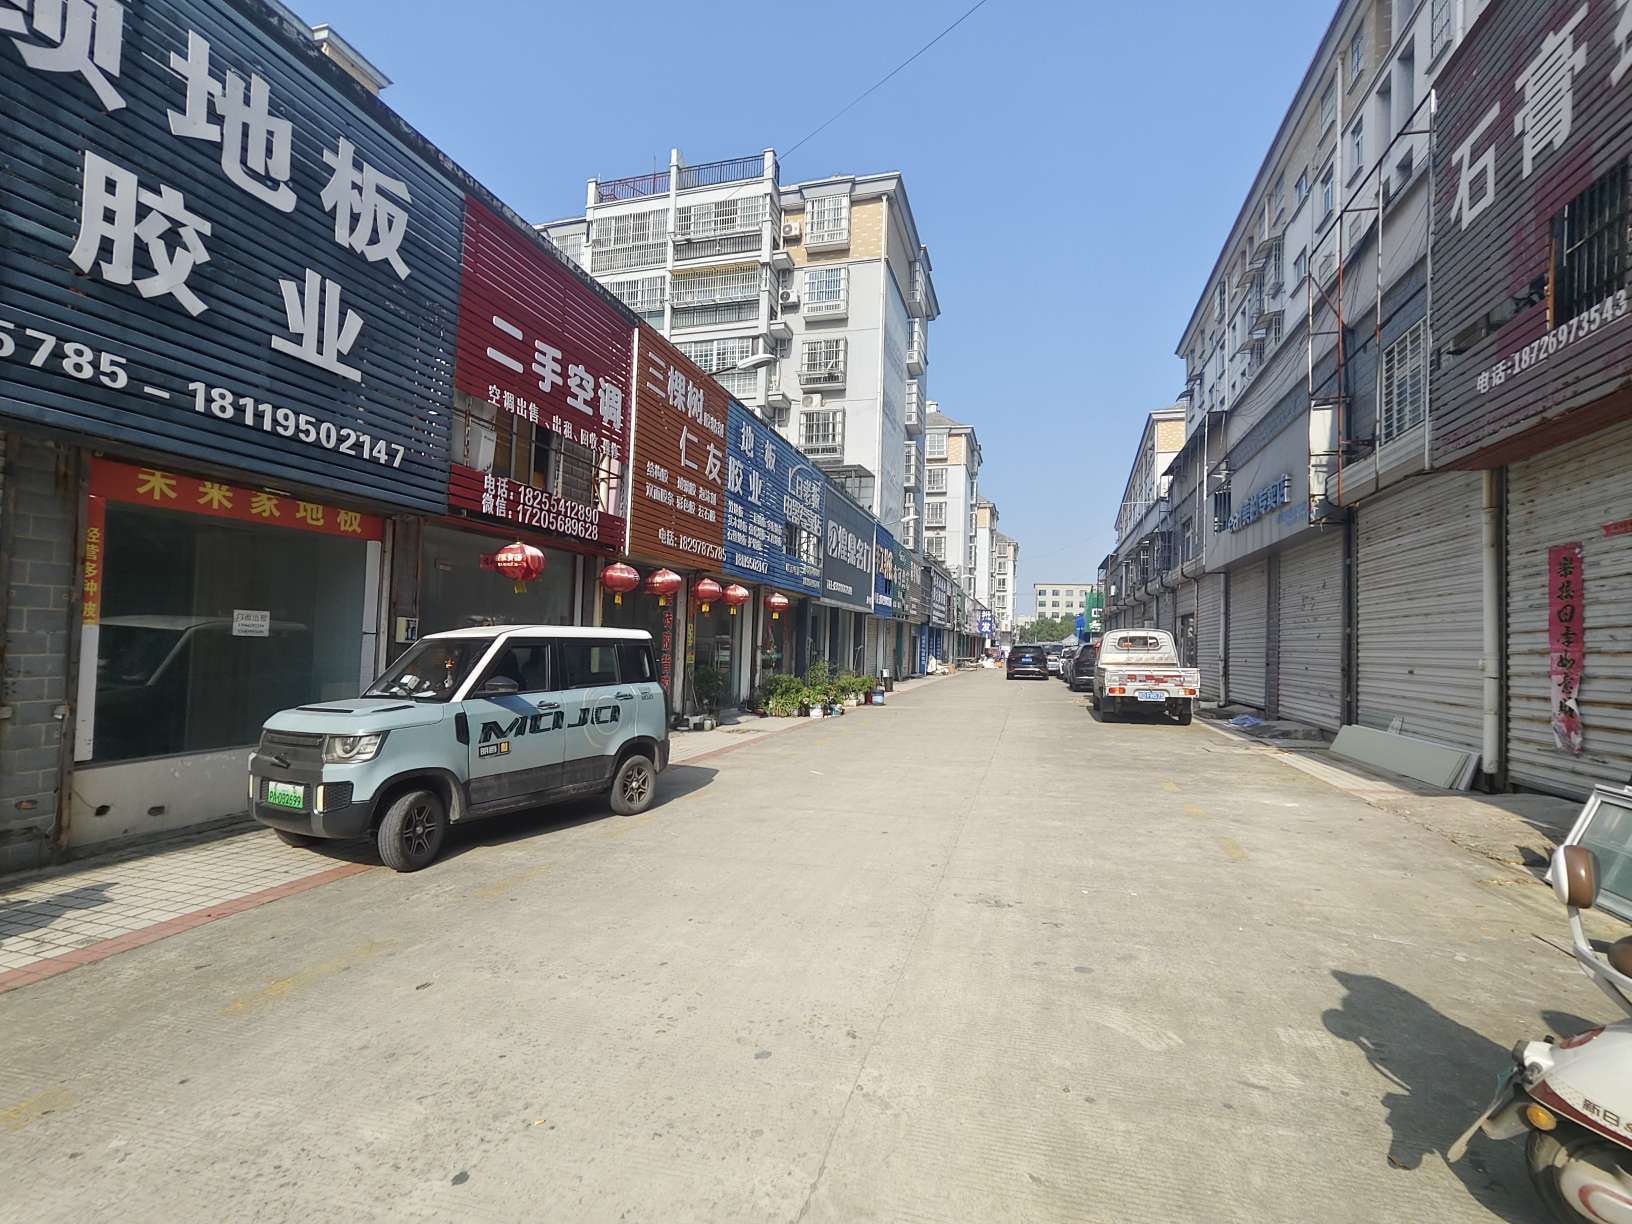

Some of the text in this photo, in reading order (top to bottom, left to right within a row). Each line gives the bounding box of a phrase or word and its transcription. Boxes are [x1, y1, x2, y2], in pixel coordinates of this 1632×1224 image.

[69, 150, 364, 383] 胶业
[487, 315, 623, 430] 二手空调
[646, 351, 704, 425] 三棵树
[188, 381, 405, 469] 18119502147
[679, 425, 722, 485] 仁友
